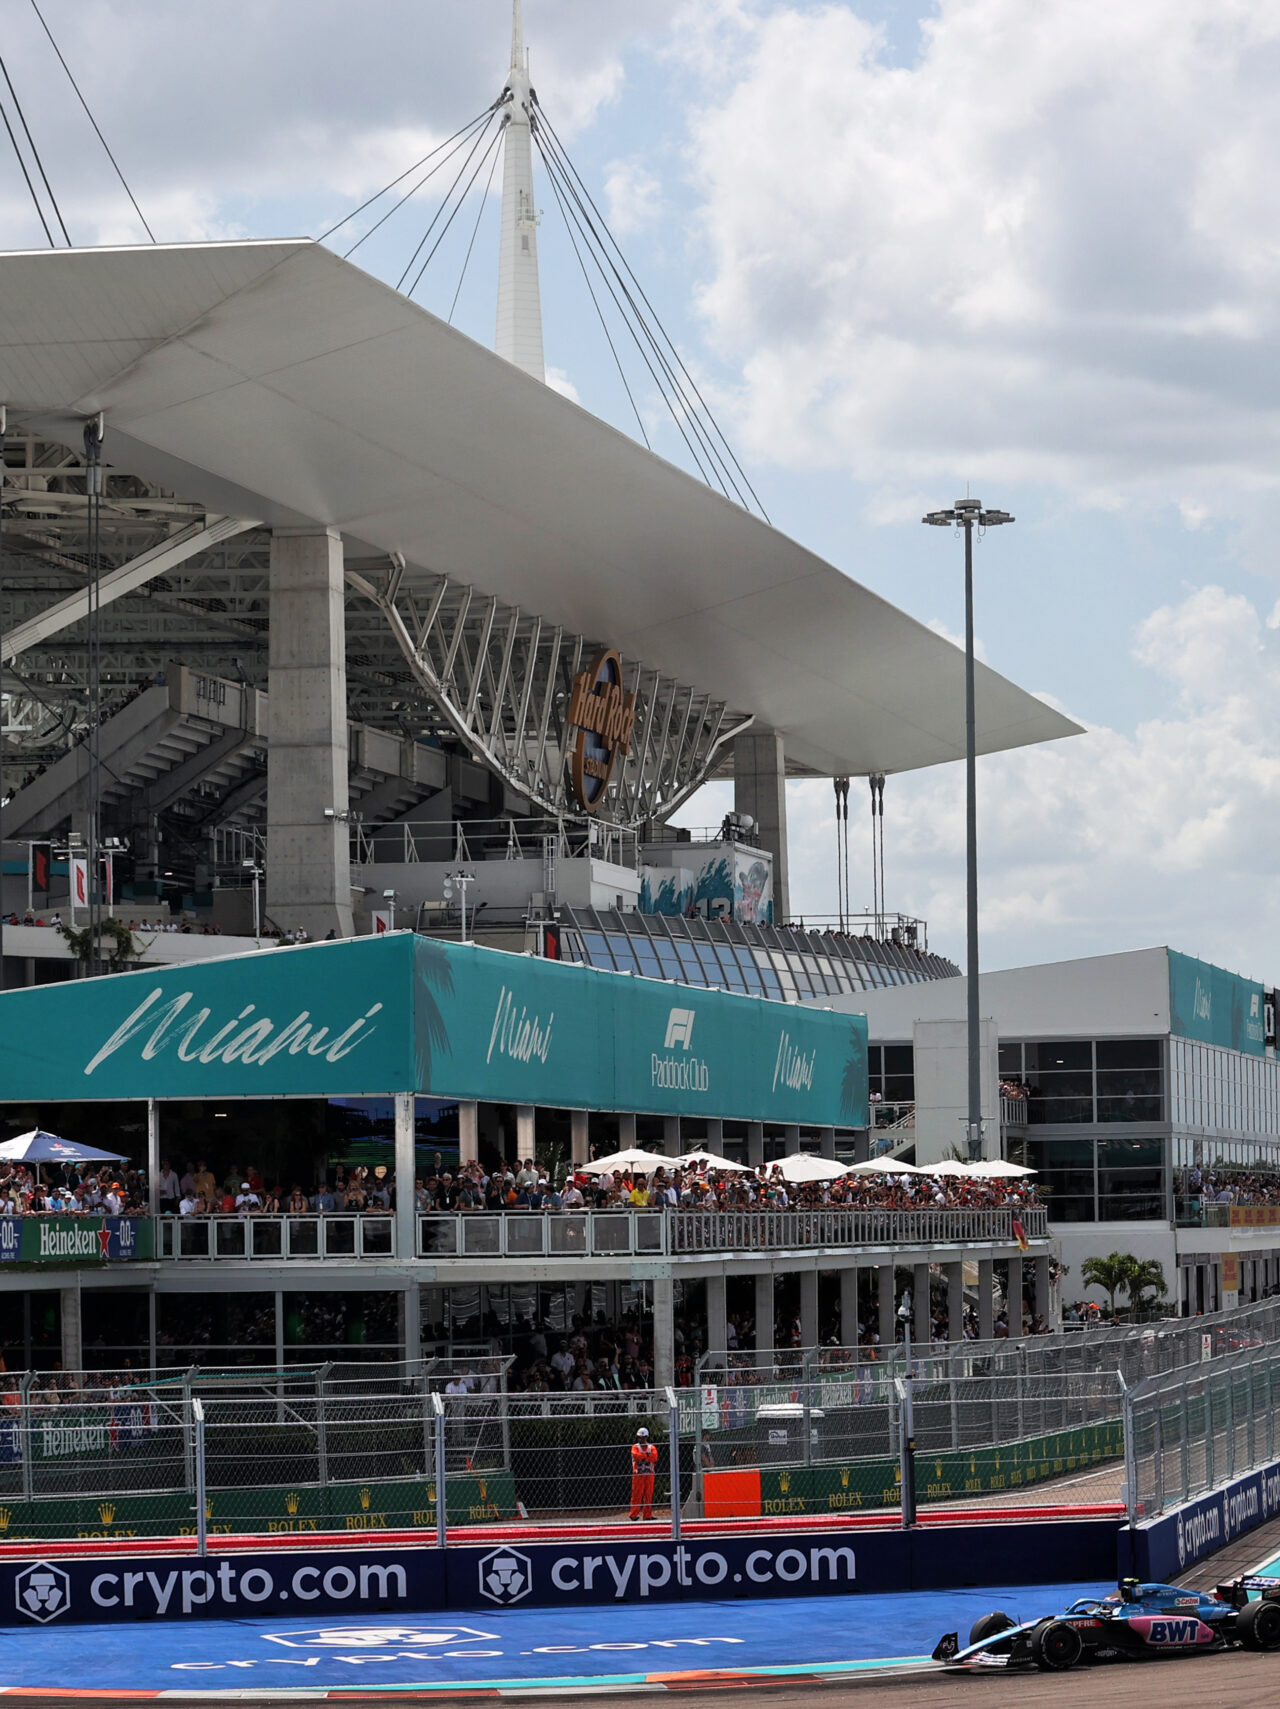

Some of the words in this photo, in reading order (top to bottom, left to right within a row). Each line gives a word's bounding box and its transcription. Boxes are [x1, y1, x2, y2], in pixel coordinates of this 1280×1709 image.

[575, 672, 611, 734] Hard
[84, 987, 383, 1075] Miami
[486, 985, 554, 1065] Miami
[651, 1053, 690, 1091] Paddock
[690, 1057, 709, 1092] Club
[772, 1029, 816, 1094] Miami
[40, 1223, 97, 1256] Heineken
[42, 1416, 105, 1457] Heineken
[764, 1497, 806, 1514] ROLEX
[829, 1492, 862, 1508] ROLEX
[883, 1488, 902, 1503] ROL
[928, 1483, 951, 1498] ROLEX
[1230, 1483, 1259, 1532] crypto.com
[346, 1513, 388, 1530] ROLEX
[469, 1503, 500, 1520] ROLEX
[1185, 1507, 1220, 1558] crypto.com
[90, 1561, 407, 1614] crypto.com
[551, 1545, 856, 1598] crypto.com
[1149, 1619, 1200, 1643] BWT
[170, 1637, 745, 1671] crypto.com
